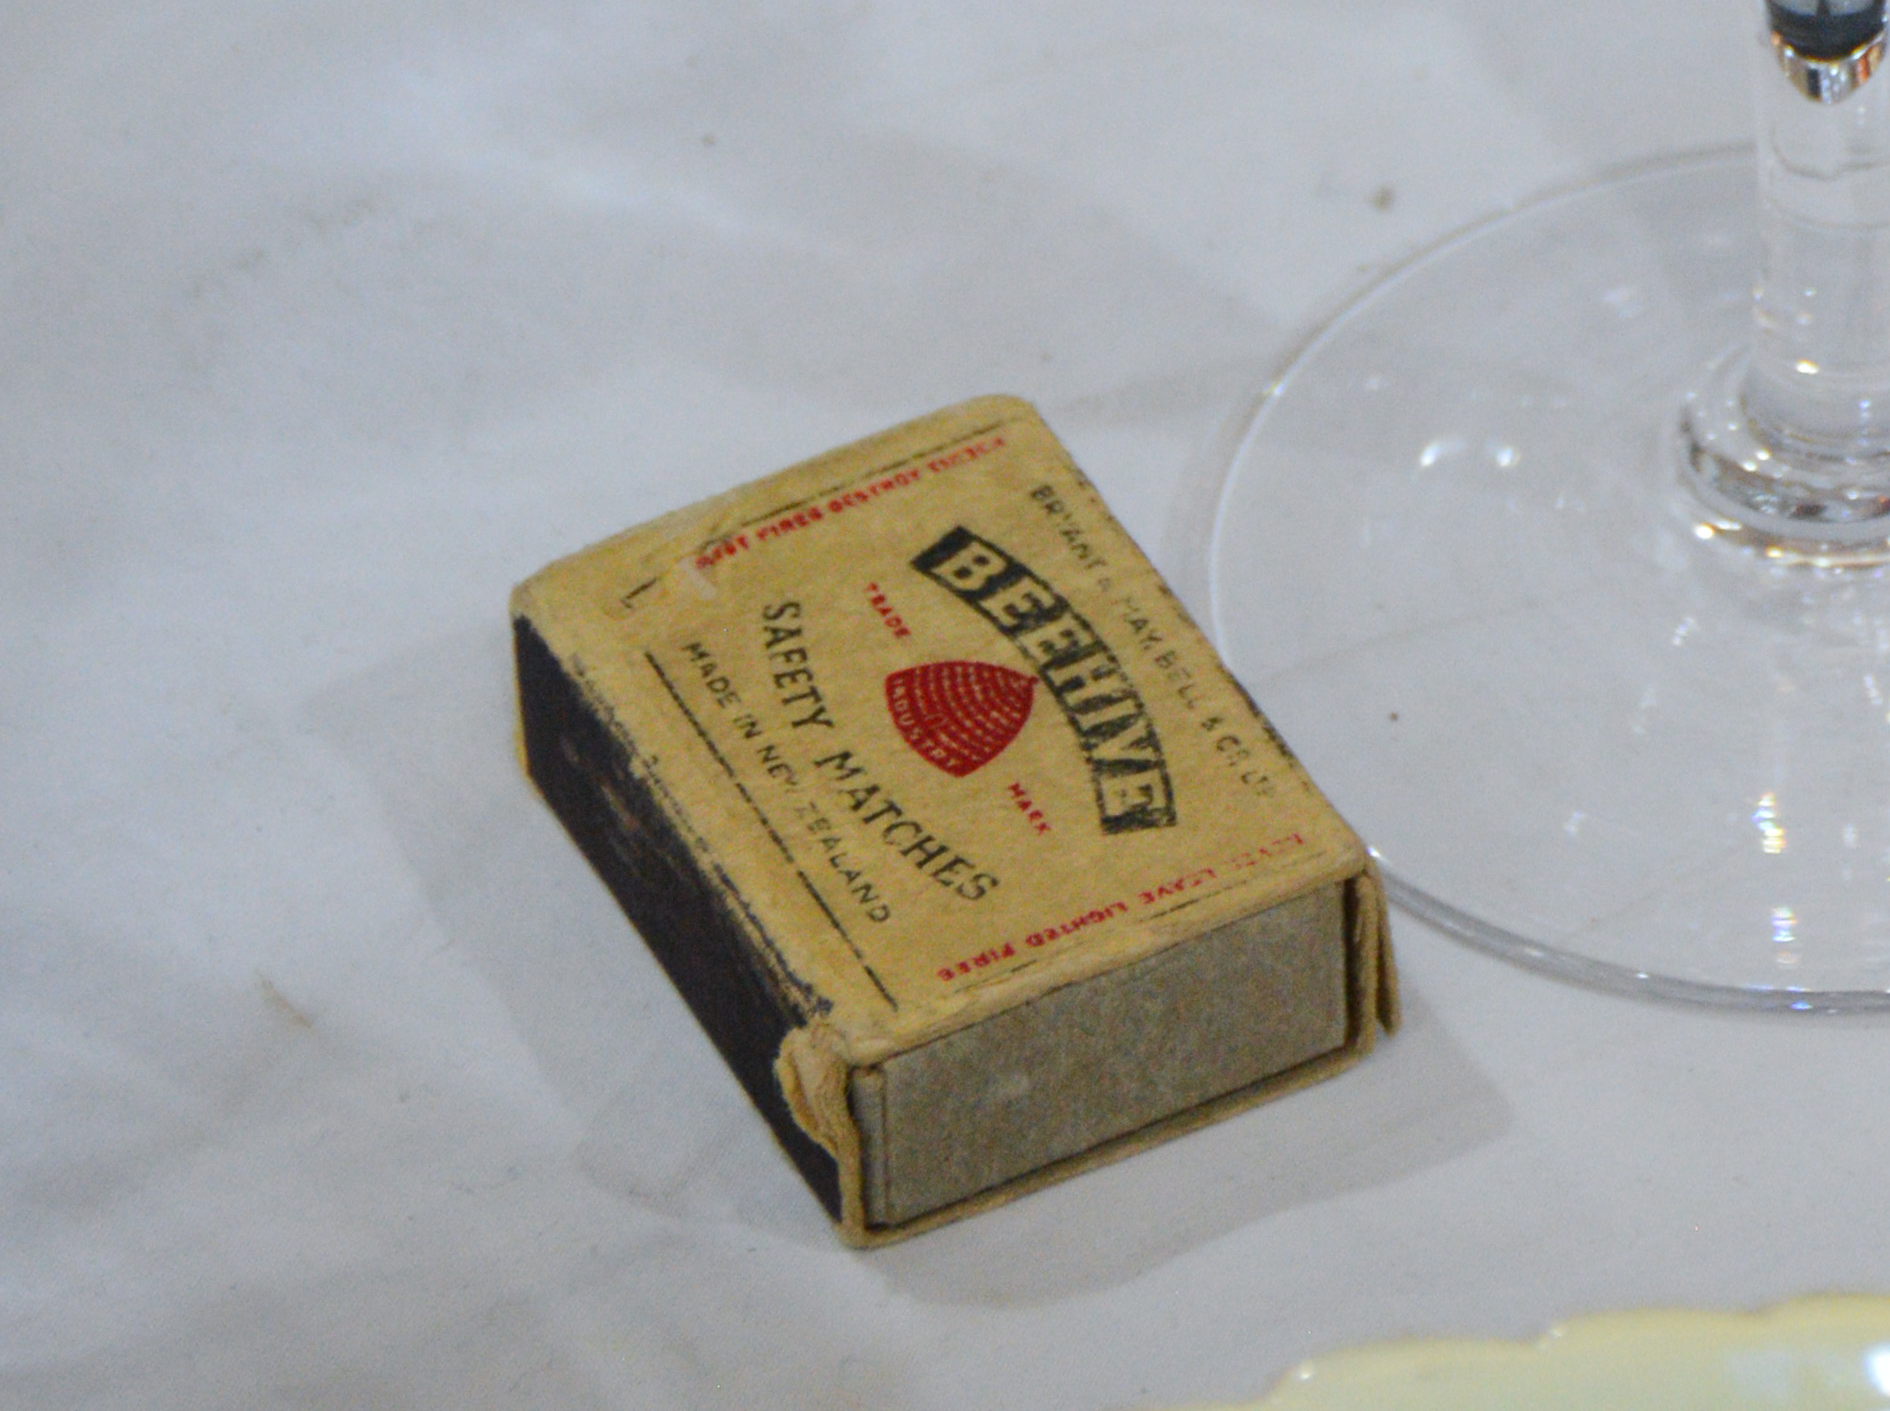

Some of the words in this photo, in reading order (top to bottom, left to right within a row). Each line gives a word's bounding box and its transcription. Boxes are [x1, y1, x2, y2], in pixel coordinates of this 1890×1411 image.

[865, 581, 912, 639] TRADE
[681, 641, 743, 709] MADE
[732, 713, 762, 740] IN
[918, 529, 1175, 833] BEEHIVE
[762, 600, 835, 729] SAFETY
[813, 750, 999, 902] MATCHES
[1007, 780, 1052, 836] MARK
[1024, 900, 1130, 948] LIGHTED
[936, 942, 1017, 982] FIRES
